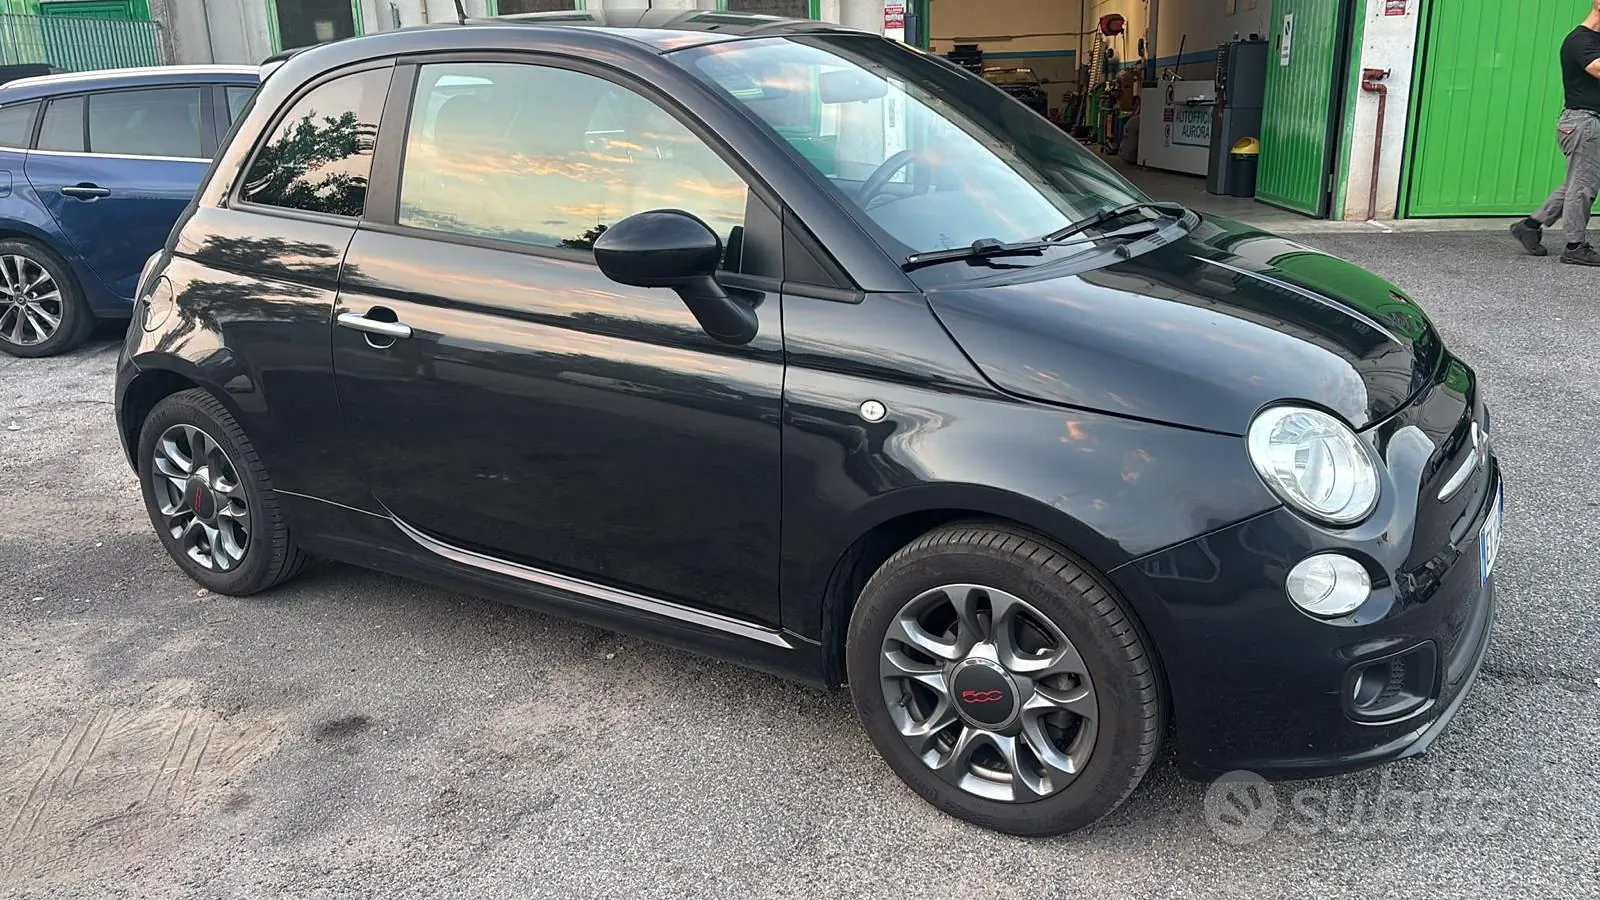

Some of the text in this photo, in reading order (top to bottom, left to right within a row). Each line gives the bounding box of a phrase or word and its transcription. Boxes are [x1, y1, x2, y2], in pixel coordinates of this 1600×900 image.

[1175, 109, 1211, 124] AUTOFFICI
[1181, 124, 1210, 138] AURORA
[962, 690, 1003, 704] 500
